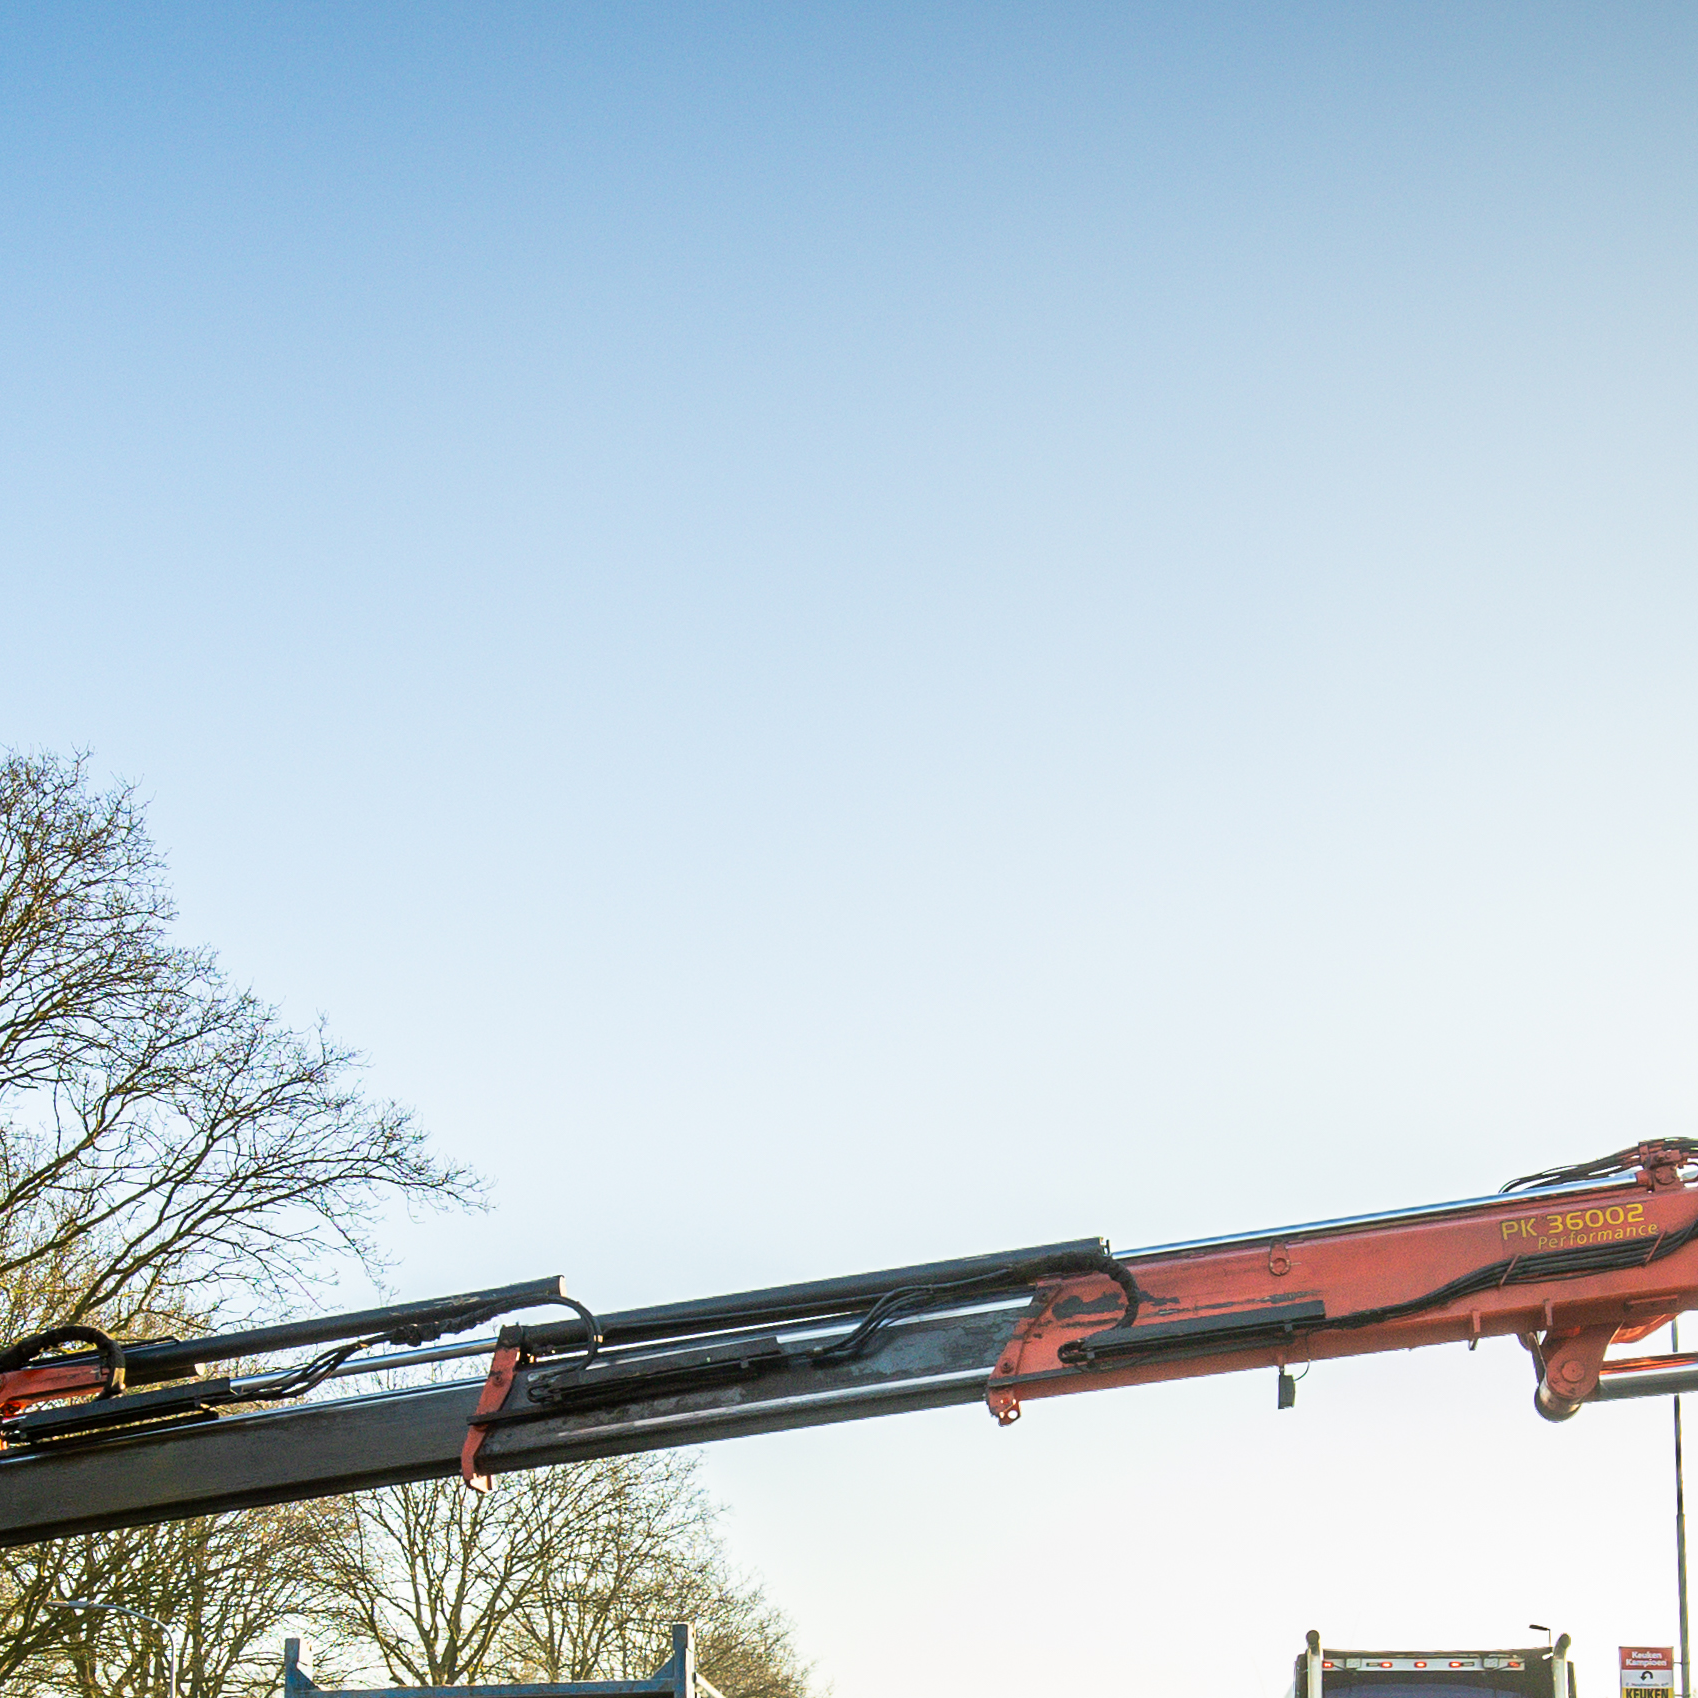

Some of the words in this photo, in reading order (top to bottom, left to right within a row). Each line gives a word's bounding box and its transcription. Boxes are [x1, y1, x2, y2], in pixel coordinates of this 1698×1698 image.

[1500, 1217, 1538, 1241] PK
[1546, 1203, 1645, 1235] 36002
[1537, 1222, 1659, 1250] Performance
